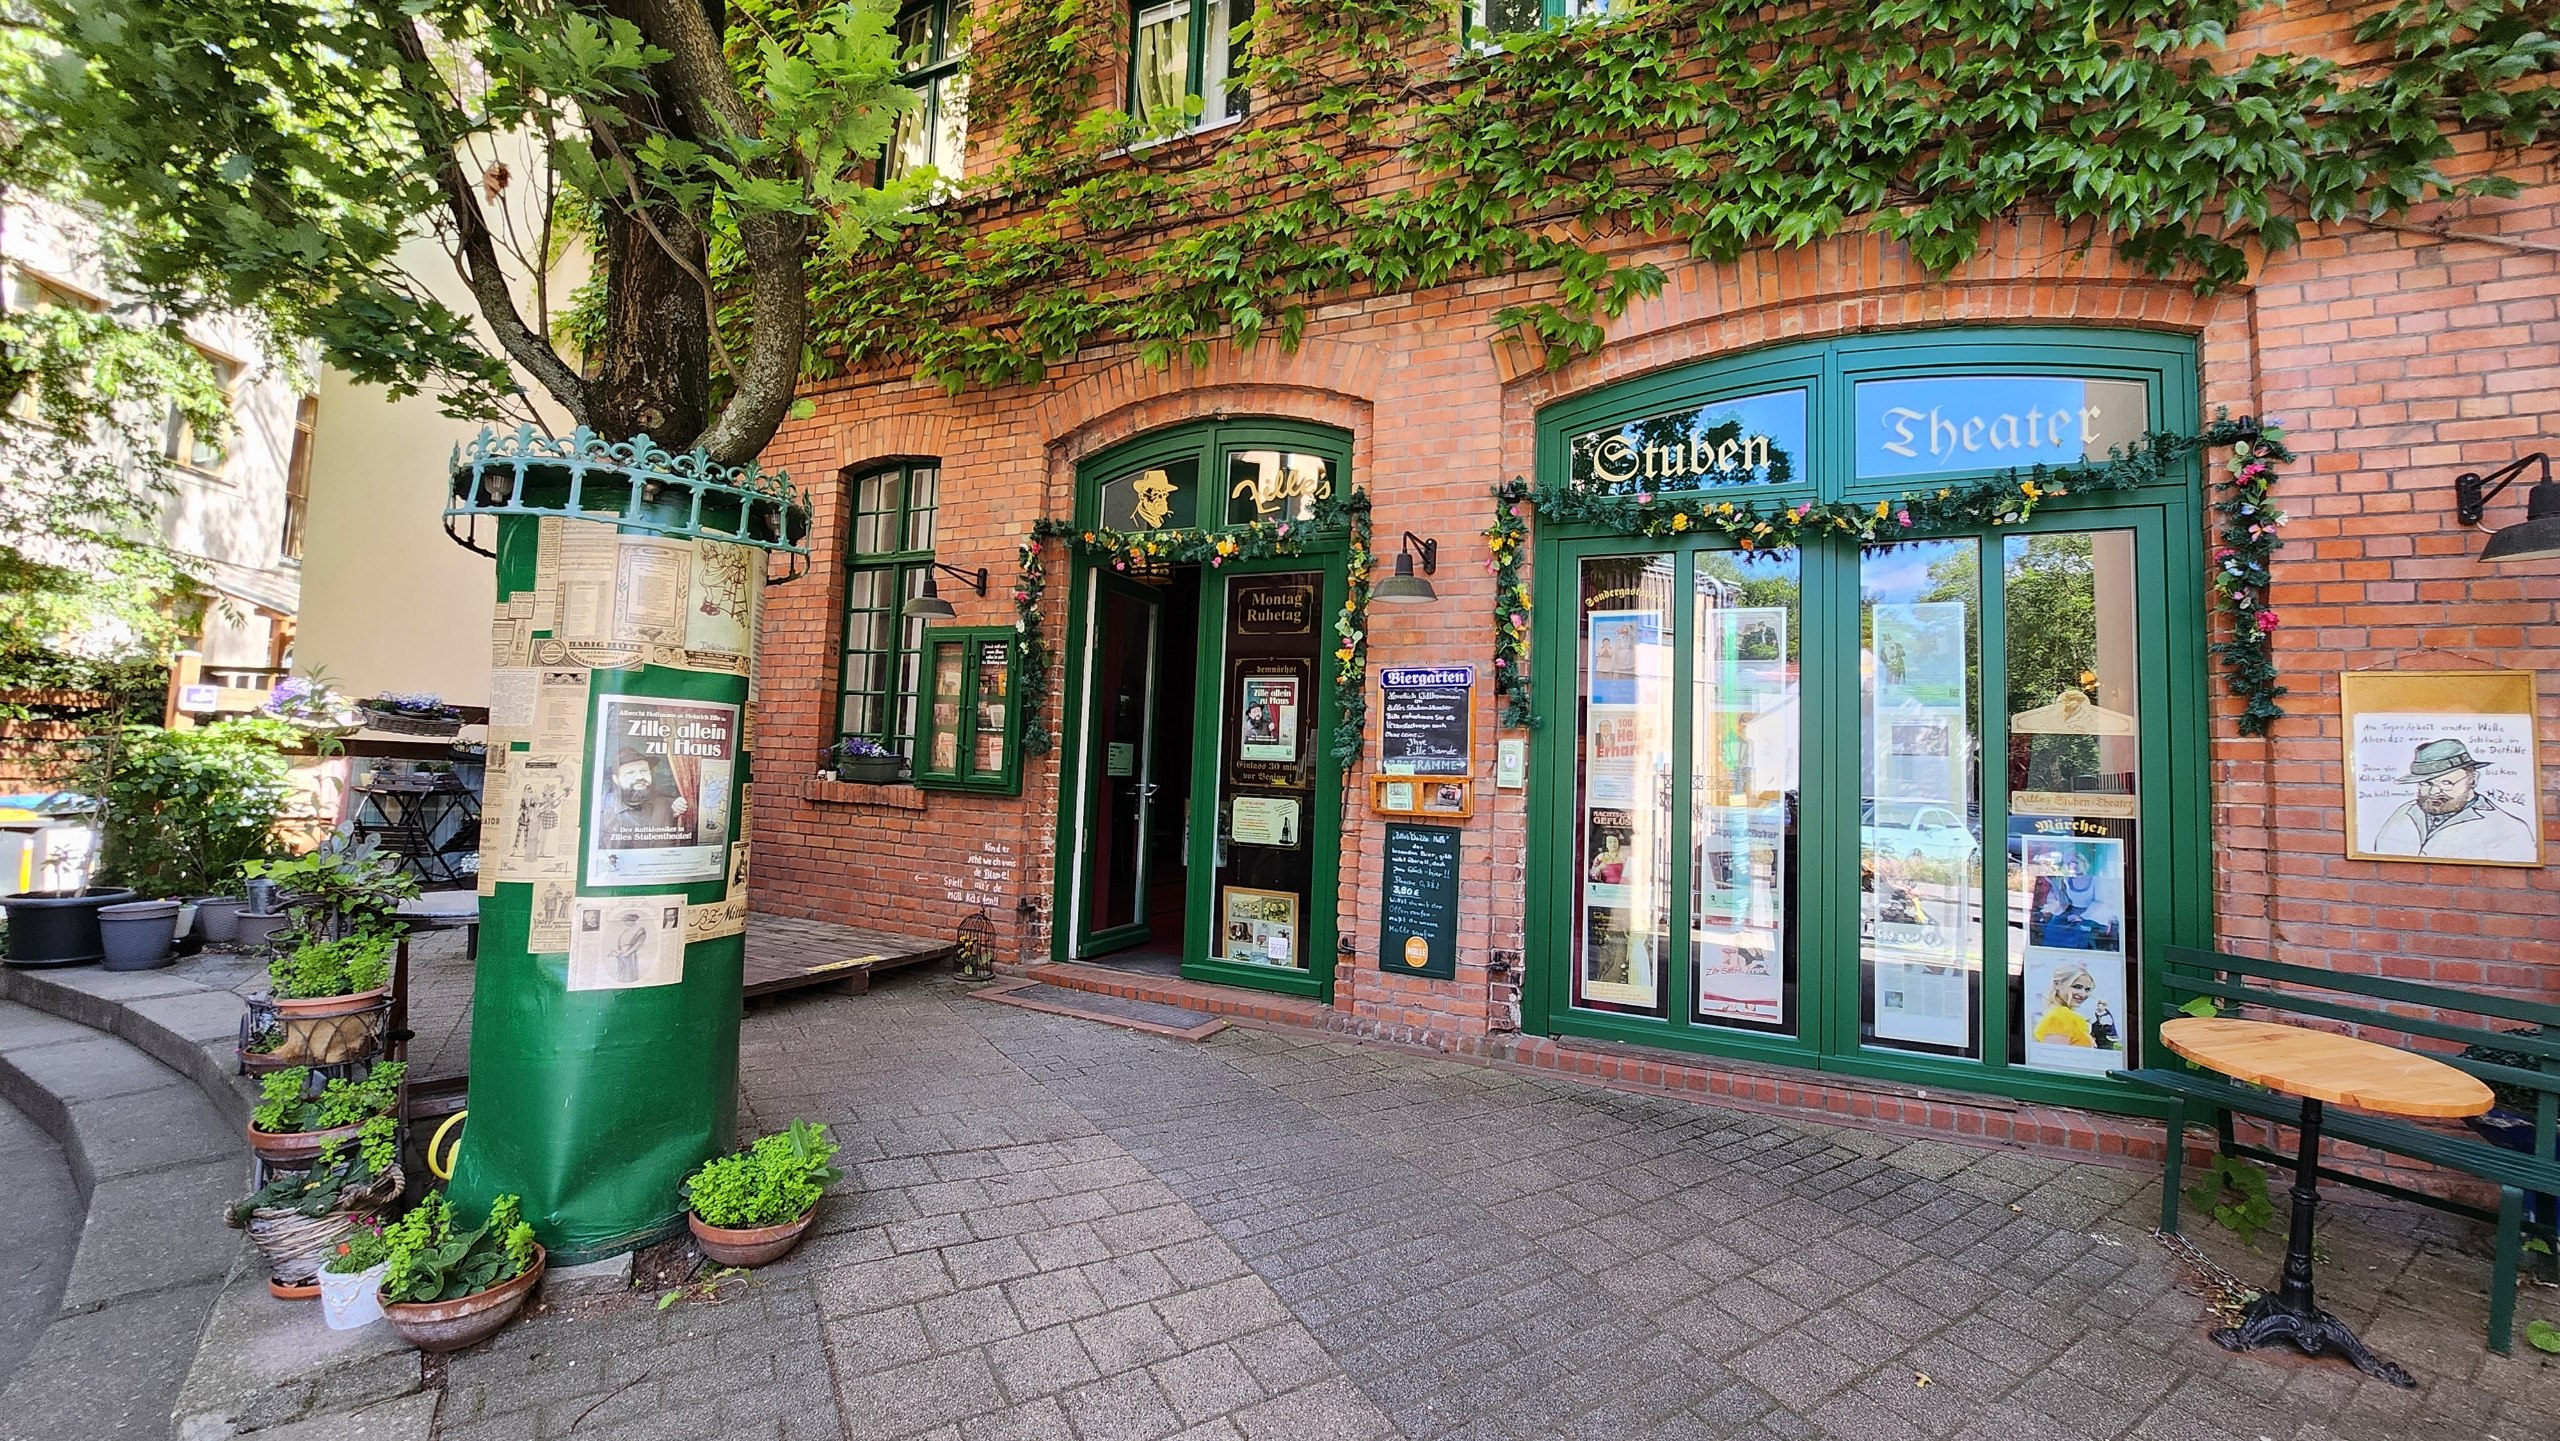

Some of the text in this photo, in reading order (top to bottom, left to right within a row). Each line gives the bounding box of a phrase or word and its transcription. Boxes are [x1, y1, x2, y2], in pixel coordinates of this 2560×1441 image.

[1881, 401, 2101, 466] Theater
[1593, 431, 1772, 483] Stuben
[1252, 593, 1302, 607] Montag
[1247, 609, 1301, 623] Ruhetag
[1388, 670, 1466, 686] Biergarten
[1254, 689, 1269, 698] Zille
[1418, 691, 1460, 700] Willkommen
[627, 719, 726, 740] Zille allein
[645, 738, 722, 756] zu Haus
[1405, 746, 1426, 756] Zille
[1268, 761, 1280, 770] 30
[2035, 819, 2108, 836] Märchen
[984, 841, 1010, 854] Kinder
[973, 867, 982, 877] de
[943, 876, 963, 888] Spielt
[993, 882, 1002, 893] de
